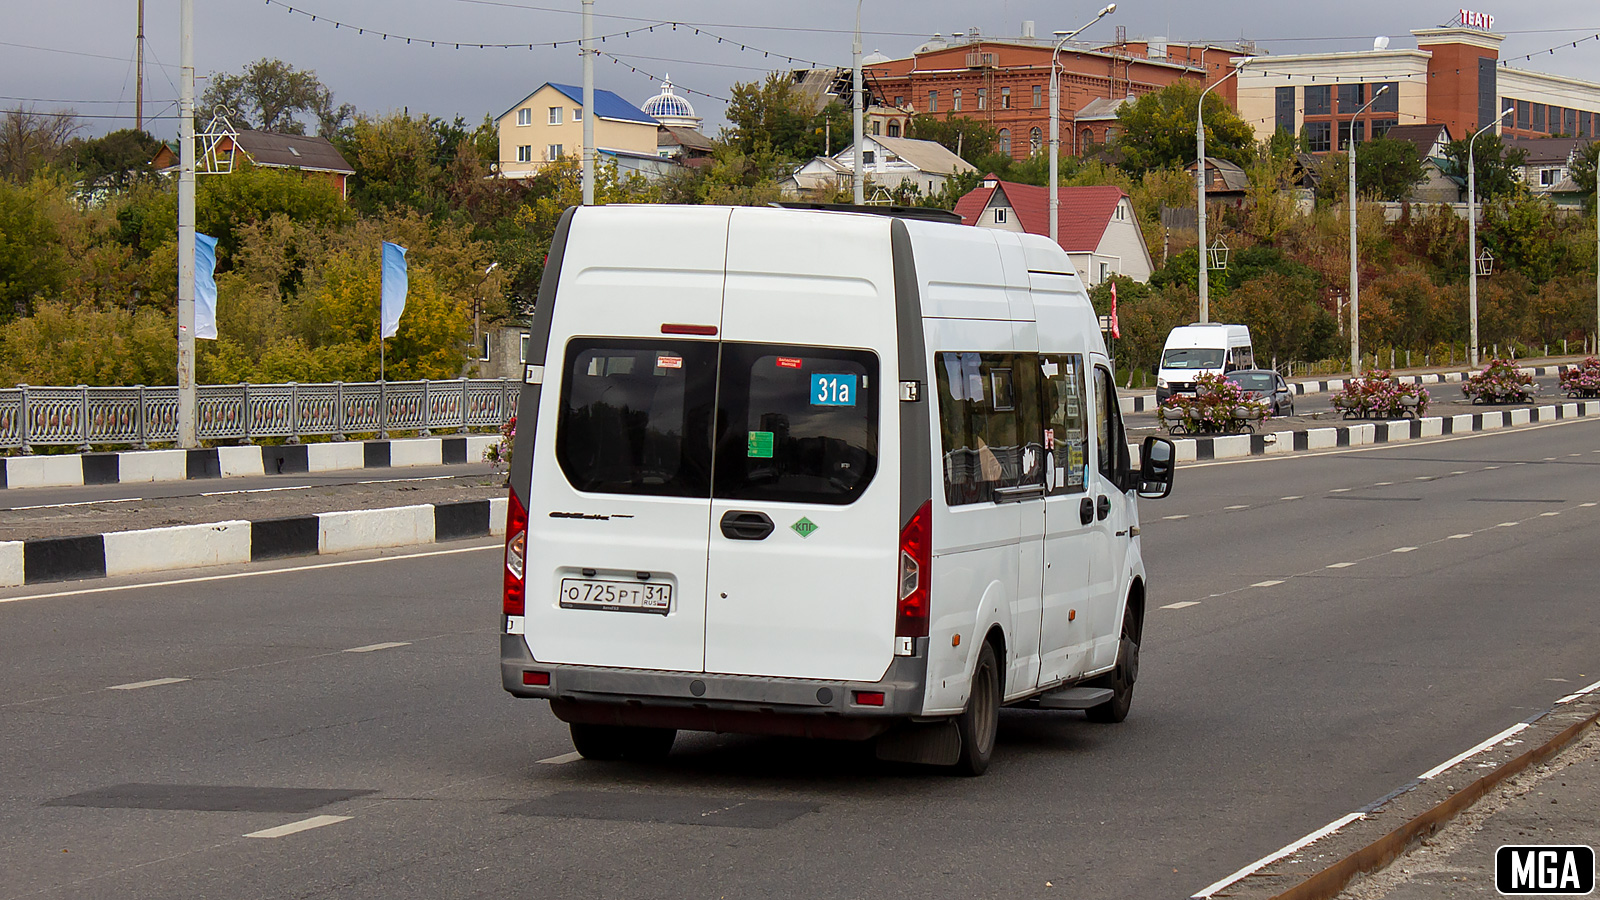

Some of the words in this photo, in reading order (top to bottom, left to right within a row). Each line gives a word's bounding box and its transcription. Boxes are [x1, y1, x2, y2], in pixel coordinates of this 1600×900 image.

[1460, 9, 1495, 29] ТЕАТР
[818, 377, 849, 402] 31а
[795, 522, 814, 531] КПГ
[645, 586, 664, 601] 31
